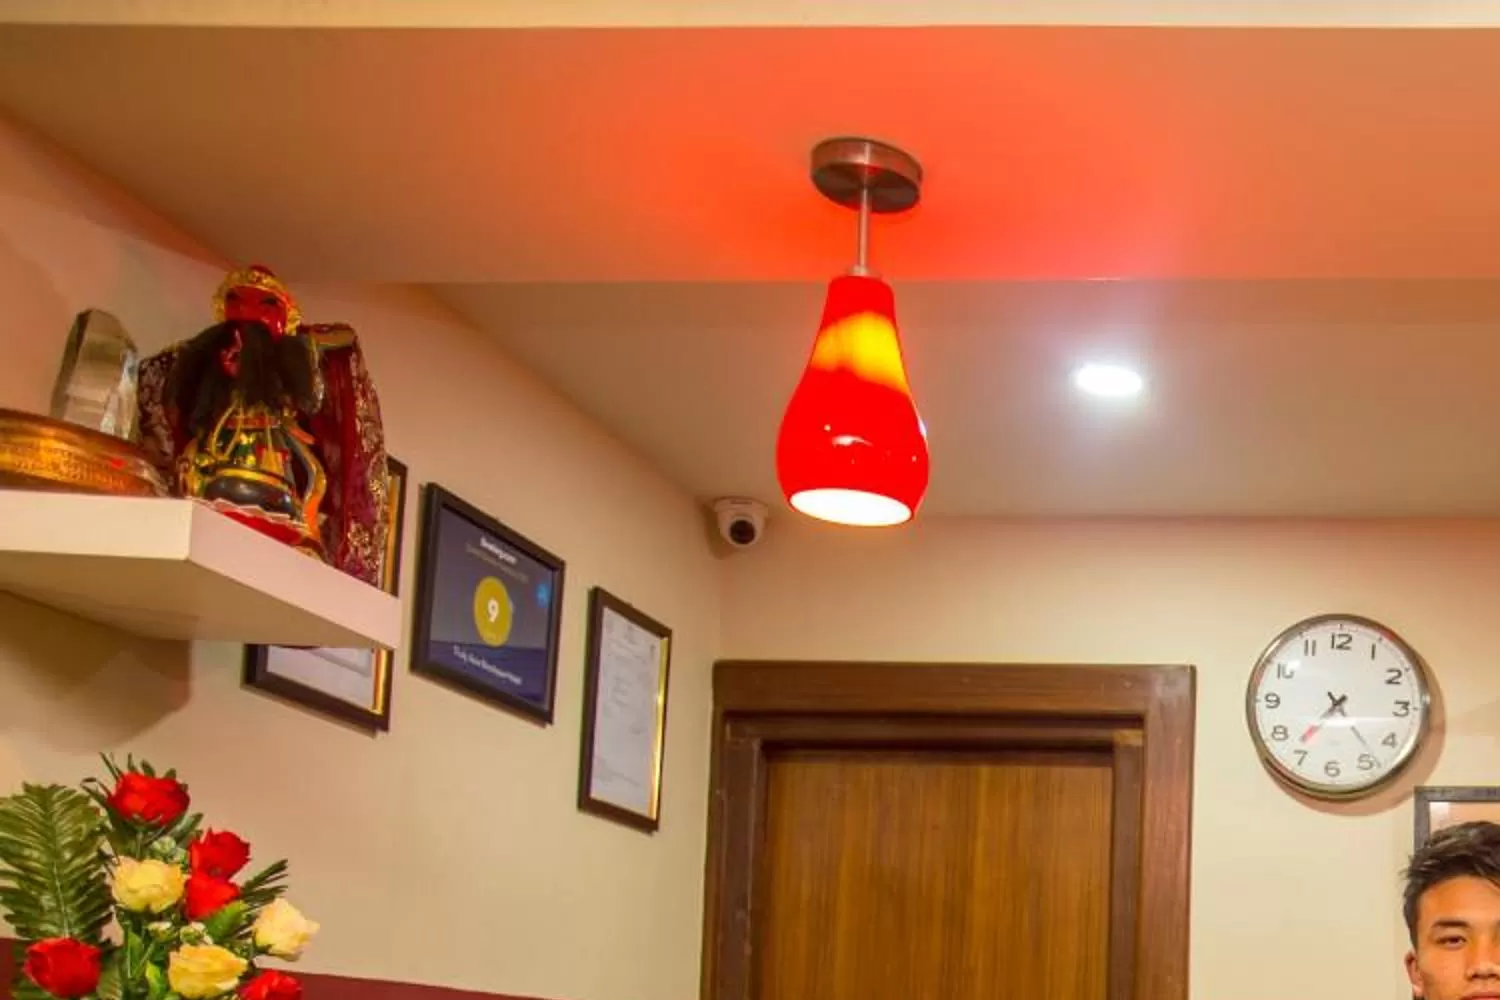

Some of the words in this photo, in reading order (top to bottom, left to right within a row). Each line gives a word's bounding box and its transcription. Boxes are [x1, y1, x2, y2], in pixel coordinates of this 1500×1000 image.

[1304, 639, 1317, 657] 11
[1330, 633, 1353, 651] 12
[1370, 643, 1377, 661] 1
[1384, 668, 1403, 686] 2
[1264, 692, 1281, 709] 9
[1391, 700, 1410, 718] 3
[1271, 724, 1289, 742] 8
[1381, 732, 1398, 749] 4
[1293, 749, 1309, 767] 7
[1357, 753, 1374, 771] 5
[1323, 761, 1341, 778] 6
